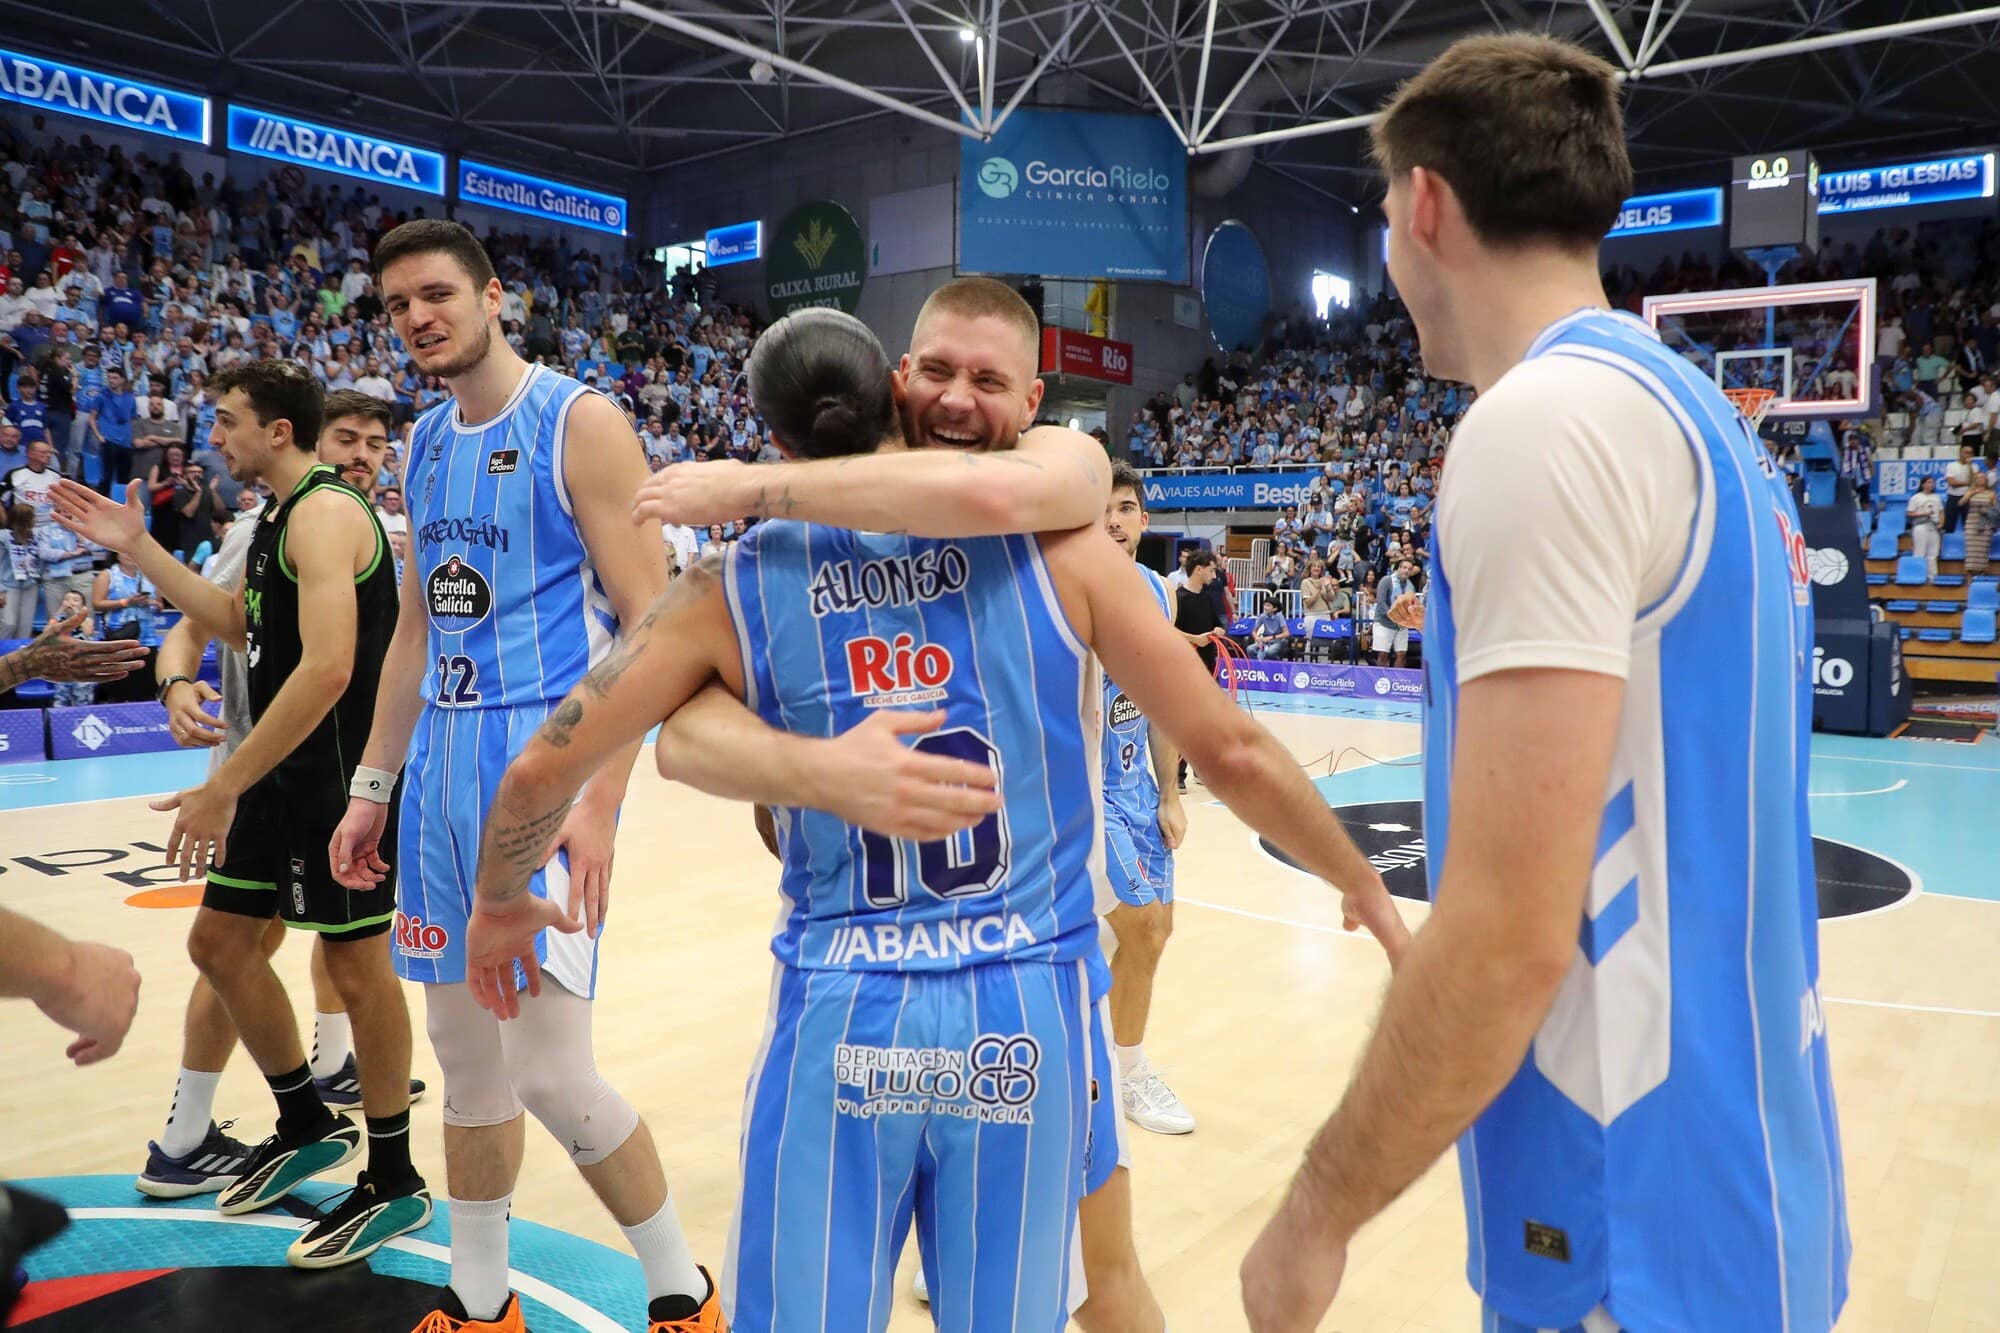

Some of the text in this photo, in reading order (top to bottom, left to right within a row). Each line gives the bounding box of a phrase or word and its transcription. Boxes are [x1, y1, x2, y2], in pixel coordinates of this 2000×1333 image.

[1751, 157, 1789, 180] 0.0
[1825, 172, 1871, 195] LUIS
[1881, 160, 1977, 188] IGLESIAS
[464, 172, 600, 222] Estrella Galicia
[1107, 194, 1168, 205] DENTAL
[771, 272, 860, 298] CAIXA RURAL
[491, 457, 503, 466] liga
[1164, 486, 1200, 498] VIAJES
[1203, 485, 1244, 497] ALMAR
[433, 577, 476, 596] Estrella
[809, 545, 967, 615] ALONSO
[434, 596, 473, 614] Galicia
[437, 654, 482, 707] 22
[866, 696, 893, 704] LECHE
[911, 690, 945, 701] GALICIA
[837, 1065, 863, 1083] DE
